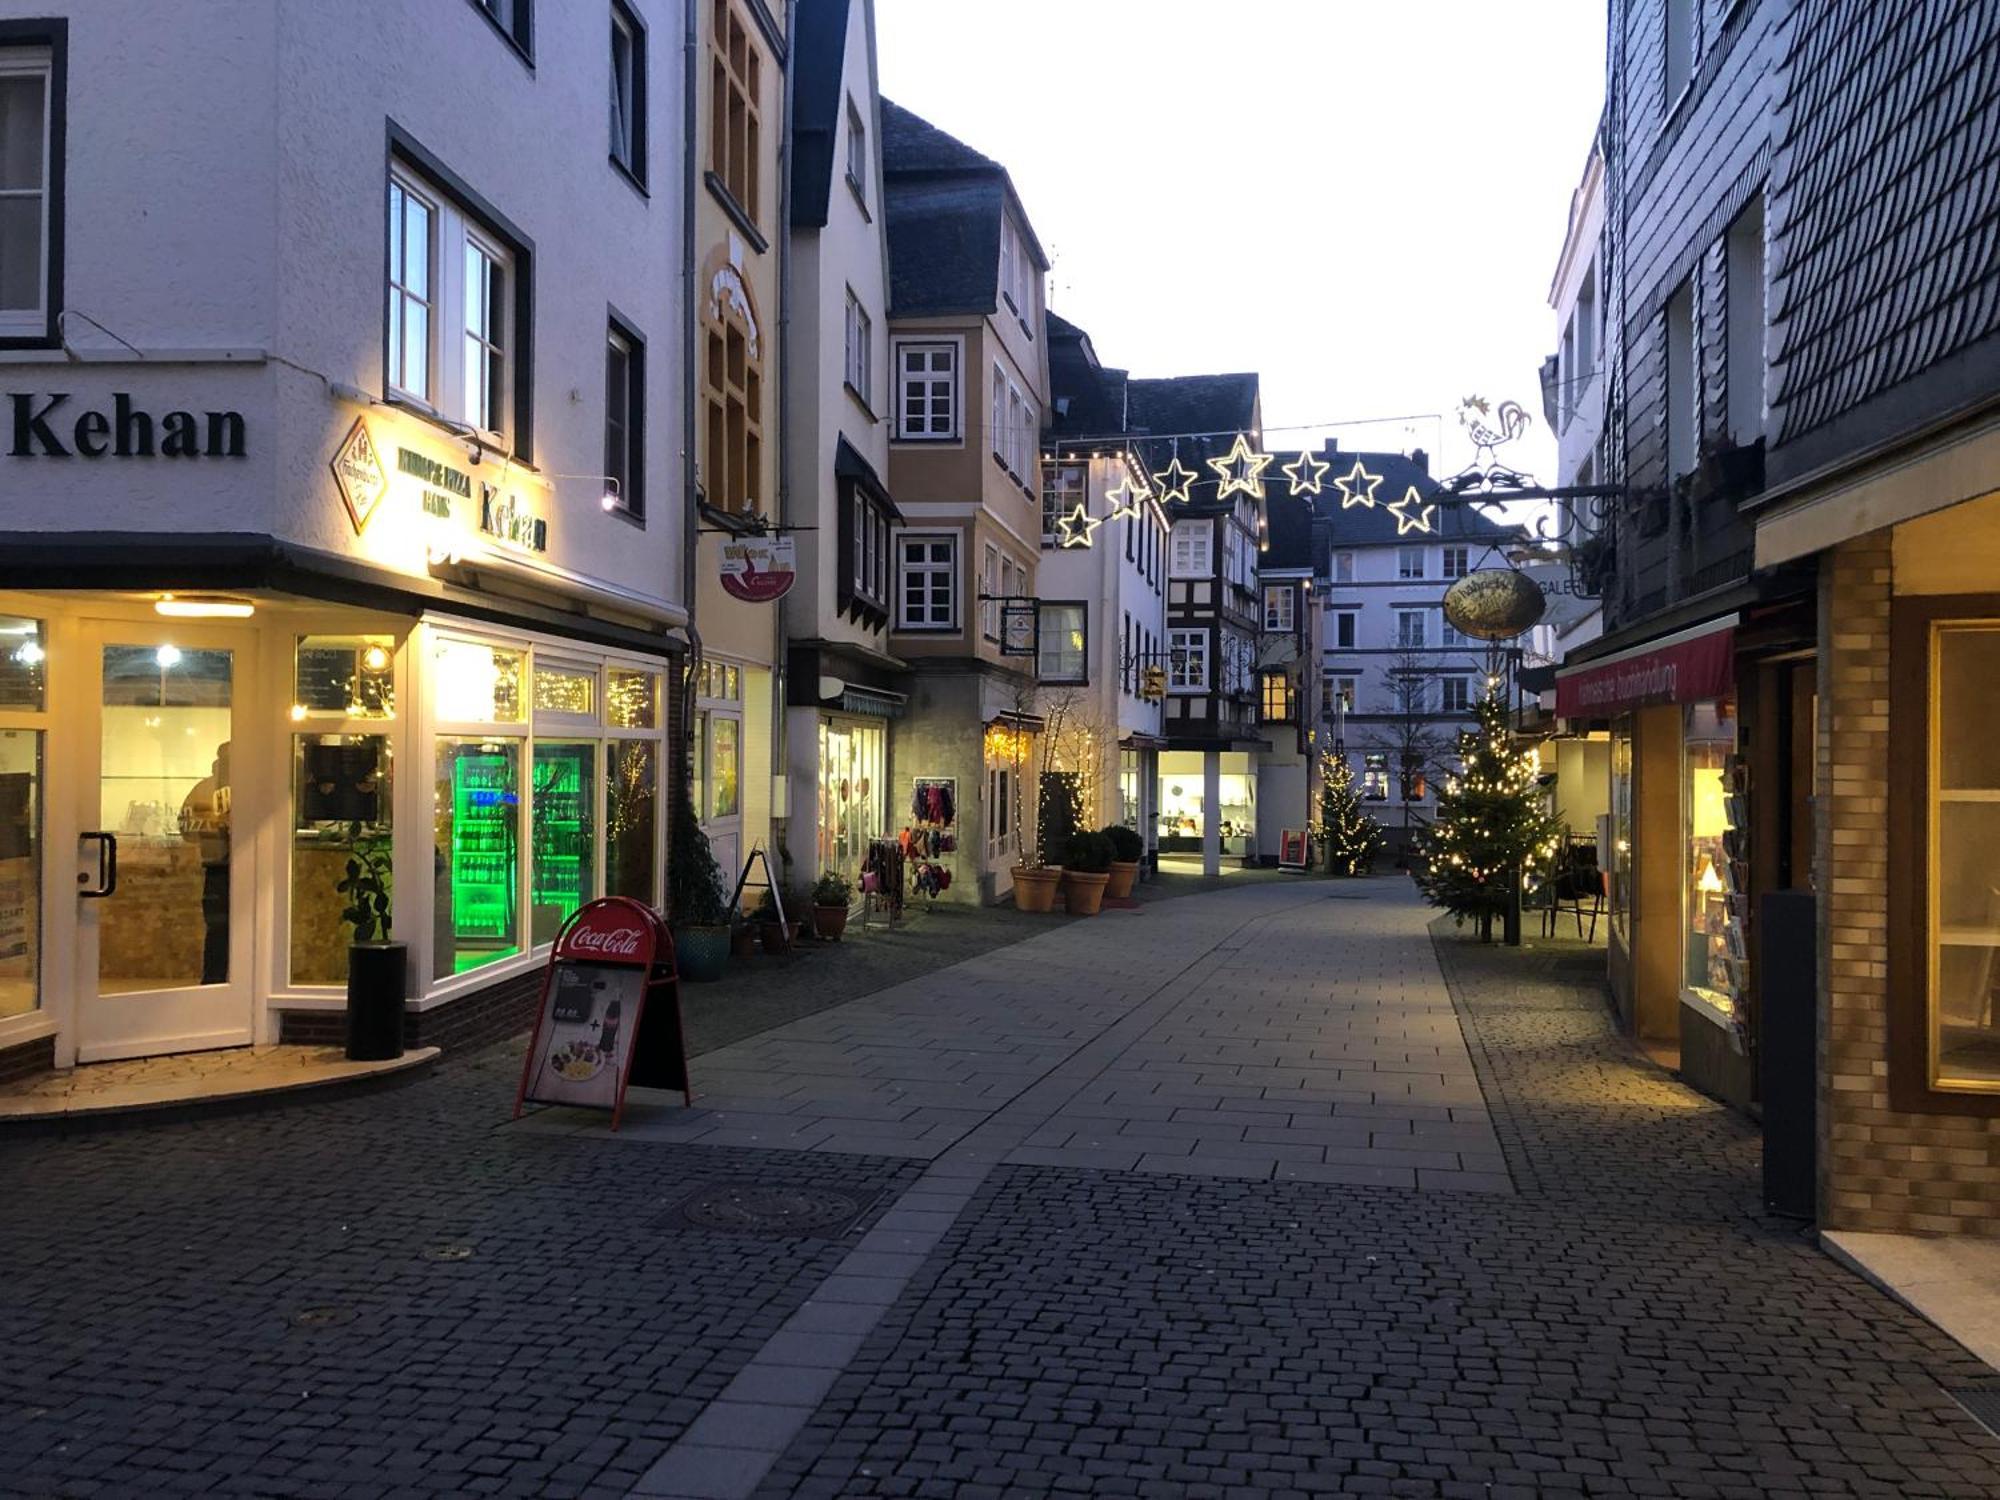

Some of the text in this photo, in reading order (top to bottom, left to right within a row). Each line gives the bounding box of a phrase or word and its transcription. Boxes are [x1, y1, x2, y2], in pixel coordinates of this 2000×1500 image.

[6, 392, 248, 457] Kehan
[443, 466, 471, 499] PIZZA
[480, 481, 547, 552] Kehan
